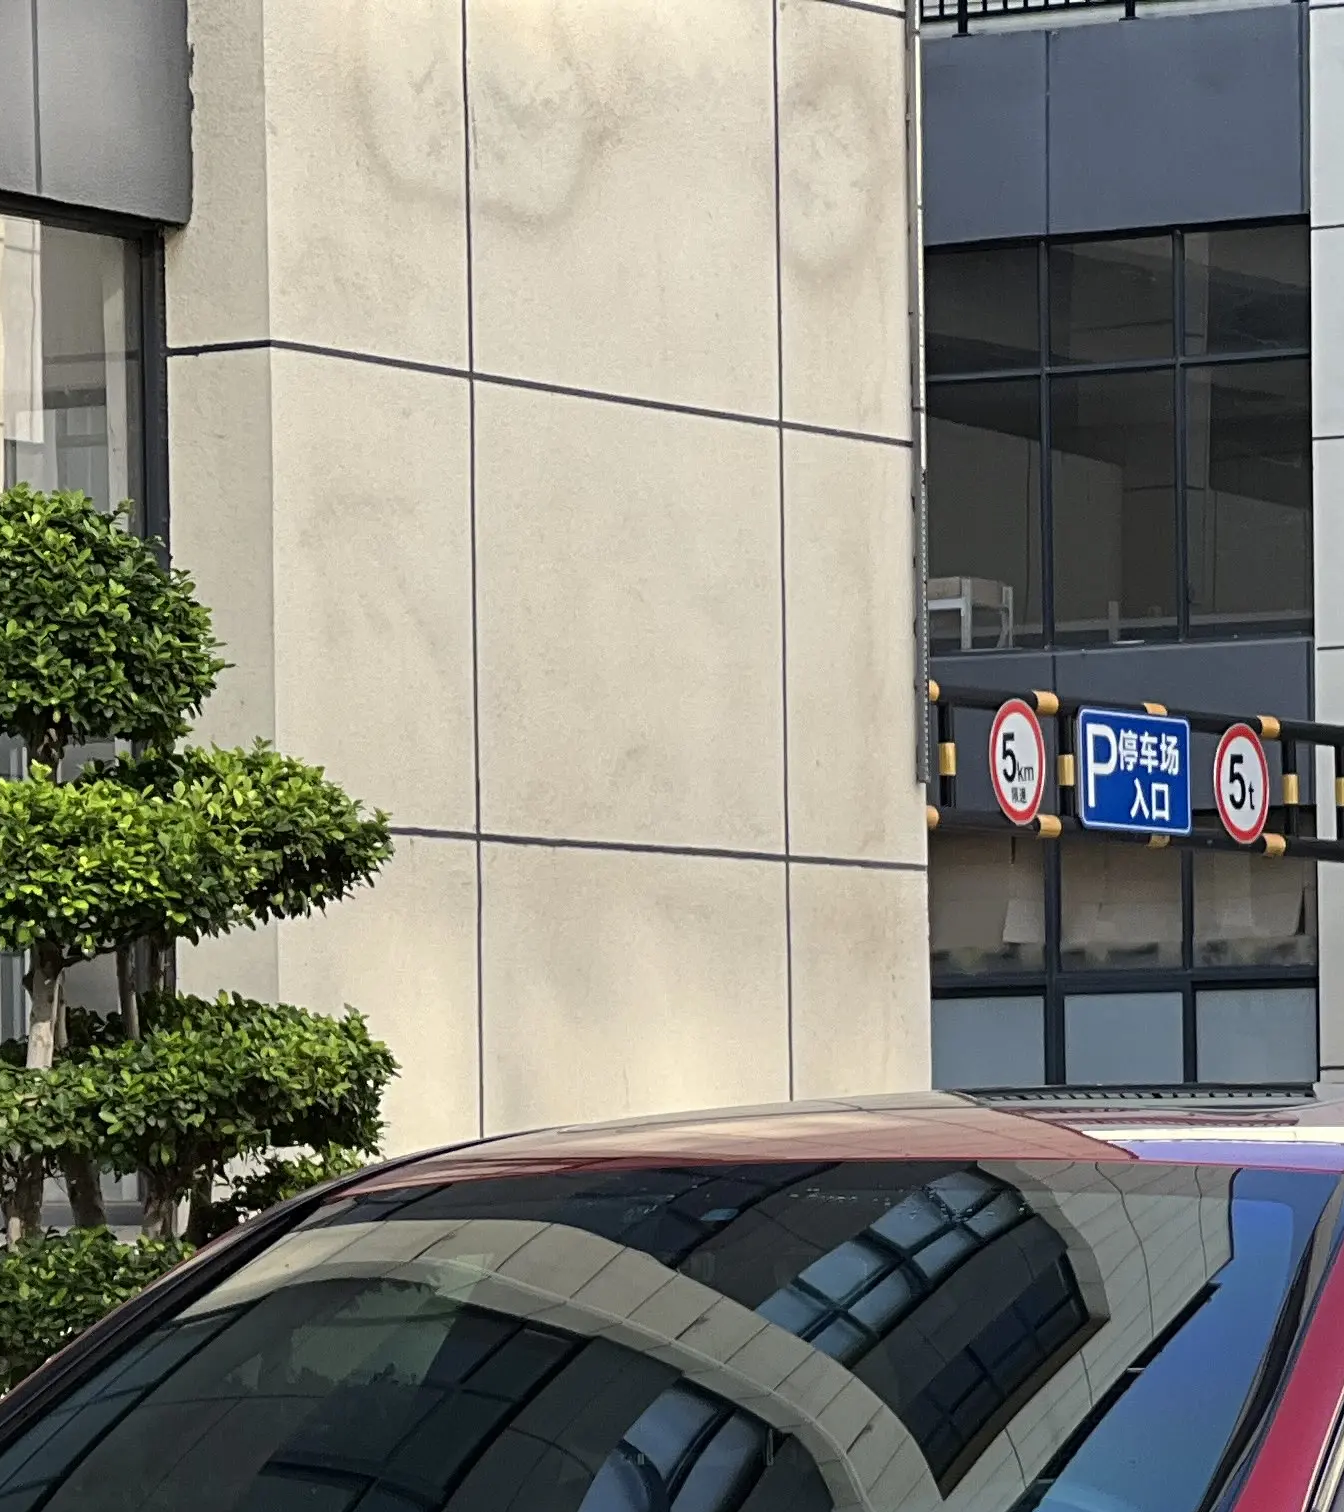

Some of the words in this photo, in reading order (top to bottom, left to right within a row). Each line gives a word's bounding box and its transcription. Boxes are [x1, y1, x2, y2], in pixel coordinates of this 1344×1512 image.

[1086, 723, 1117, 808] P
[1118, 728, 1180, 776] 停车场
[1130, 777, 1170, 821] 入口
